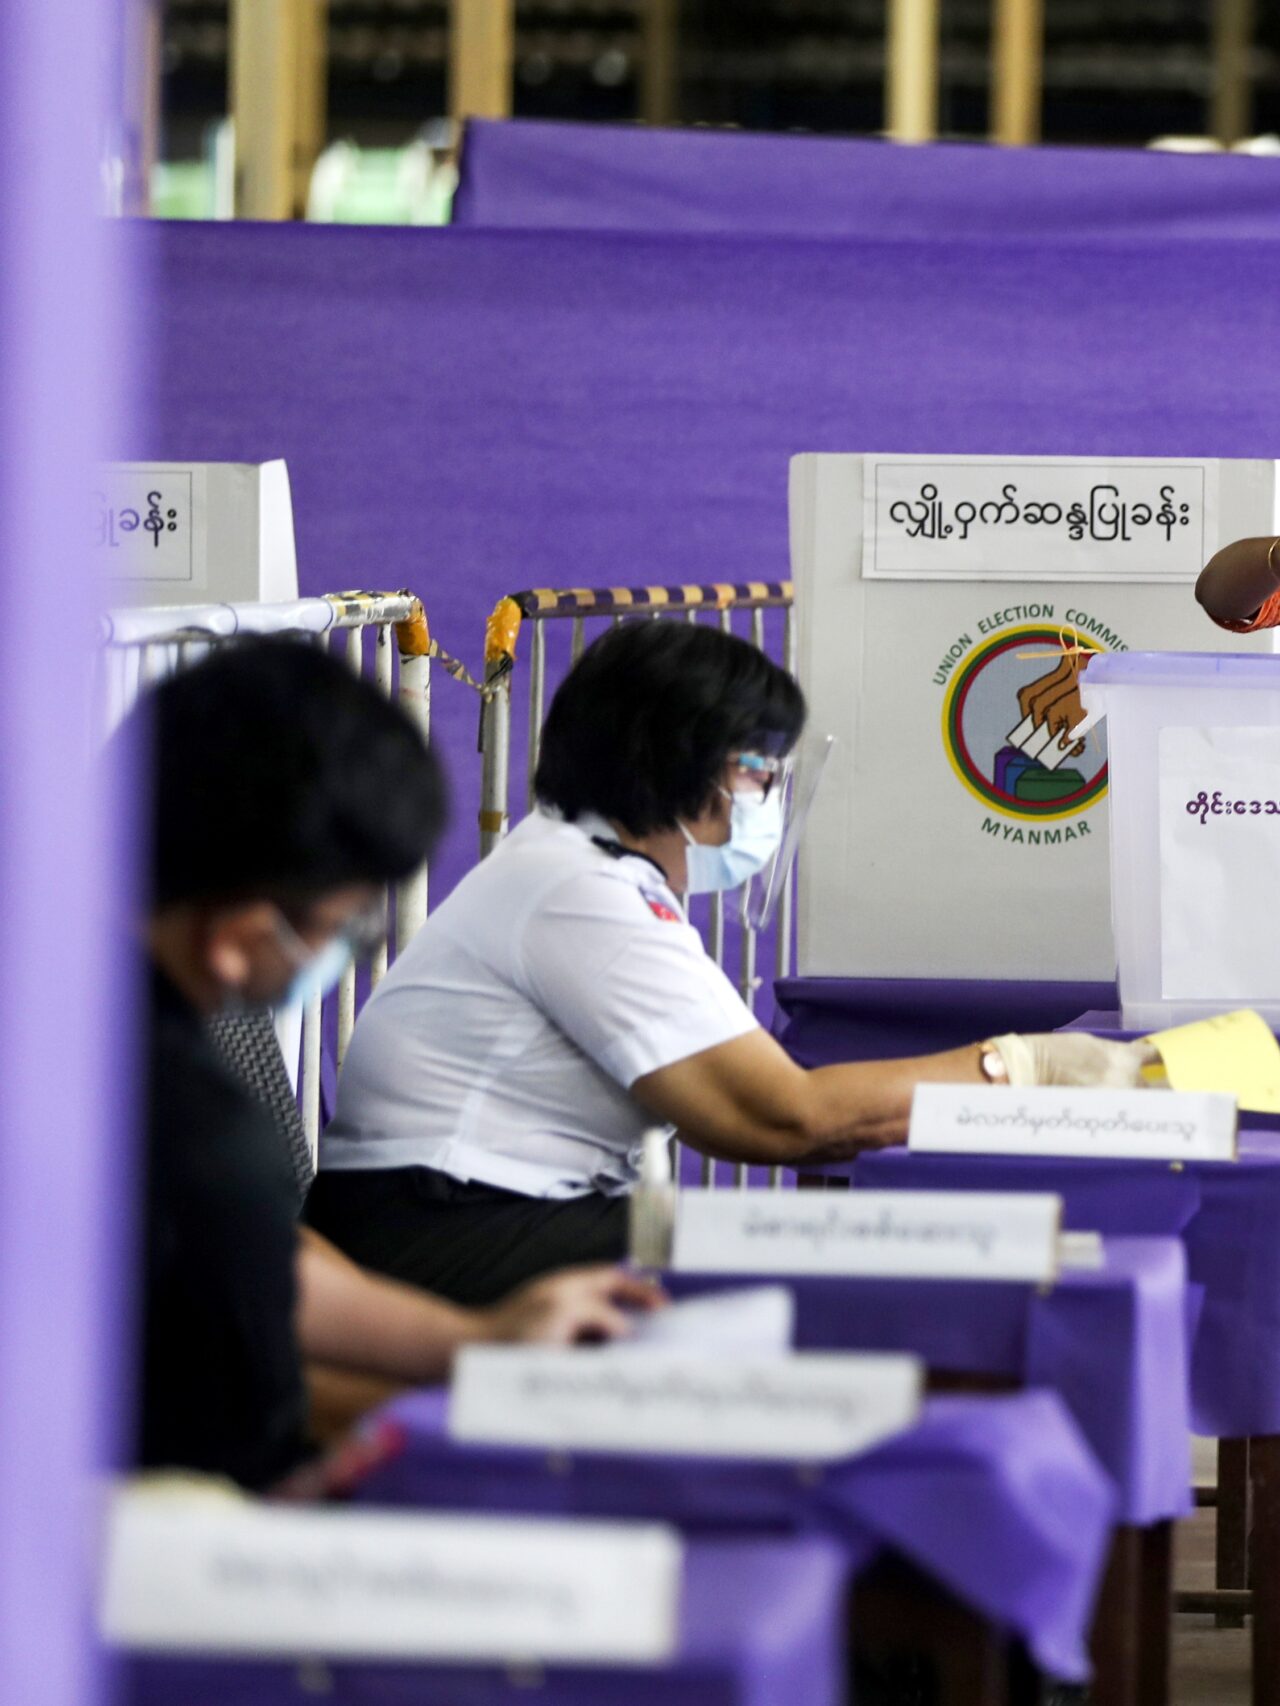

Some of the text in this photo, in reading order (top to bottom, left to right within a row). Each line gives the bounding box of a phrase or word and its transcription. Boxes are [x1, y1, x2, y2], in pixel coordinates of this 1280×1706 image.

[932, 604, 1129, 686] UNION ELECTION COMMIS
[981, 818, 1091, 845] MYANMAR
